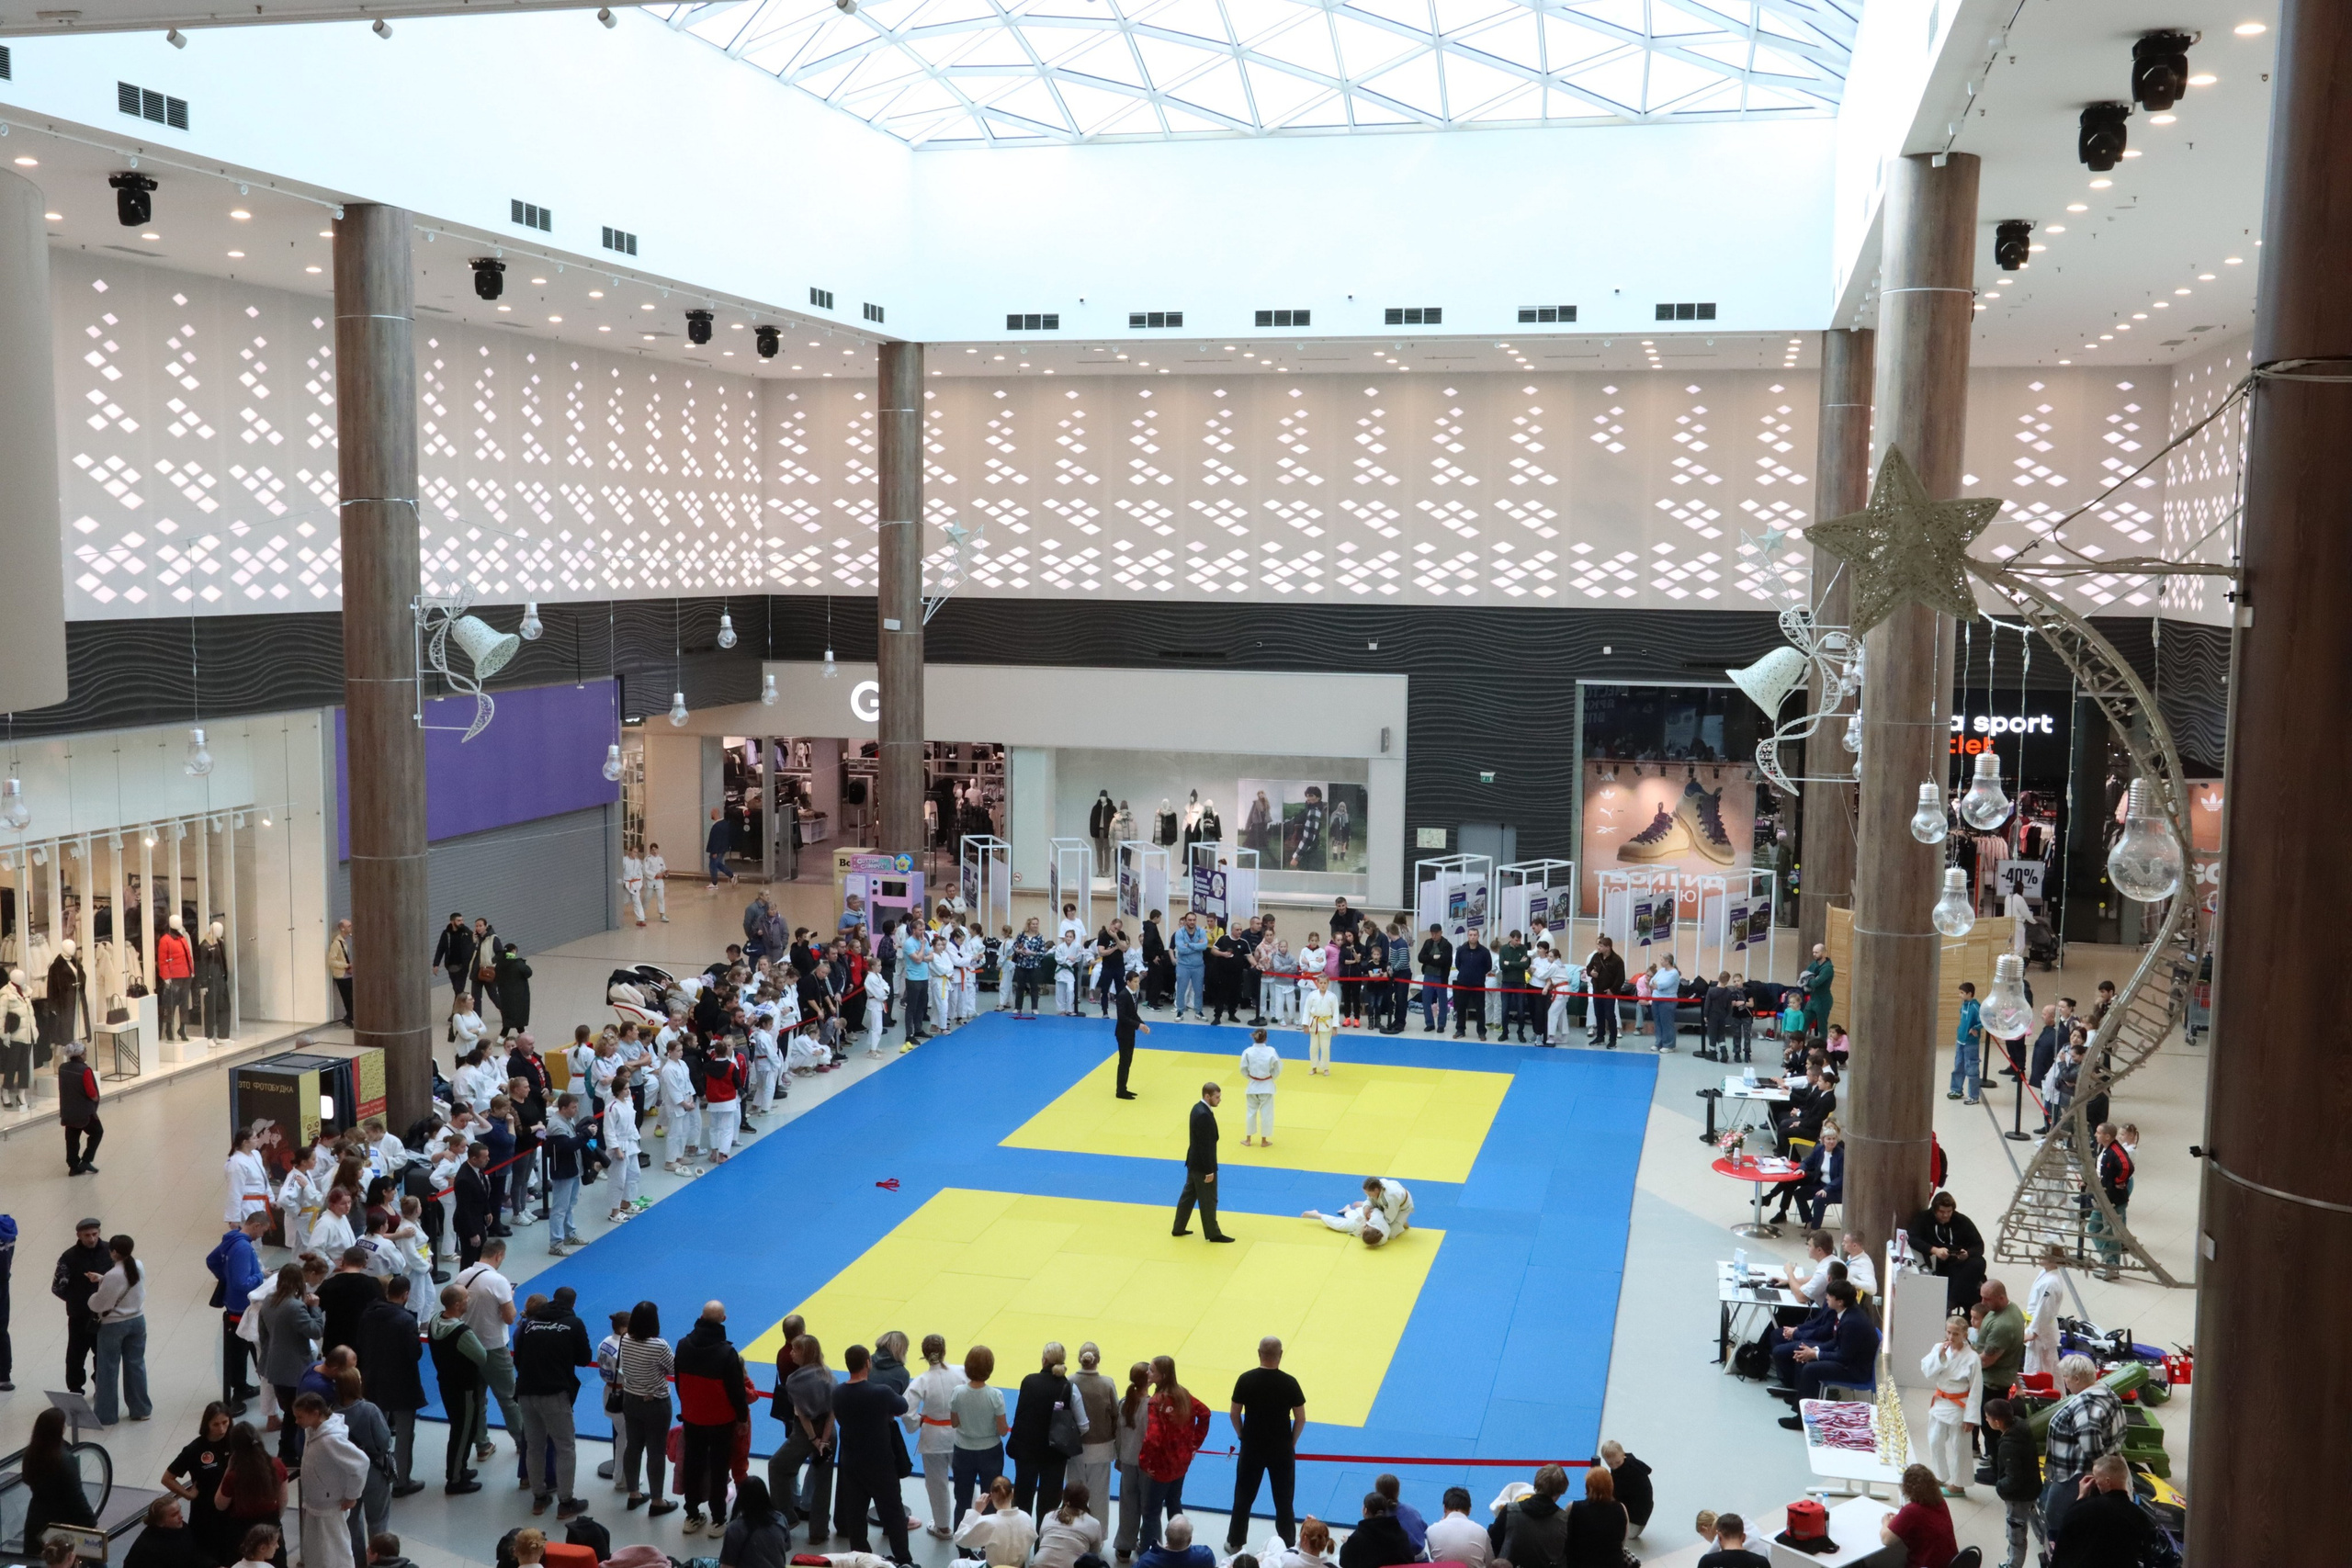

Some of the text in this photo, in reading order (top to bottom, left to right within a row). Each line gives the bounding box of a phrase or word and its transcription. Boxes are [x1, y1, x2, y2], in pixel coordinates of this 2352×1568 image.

[1973, 714, 2053, 737] sport
[2001, 867, 2038, 885] -40%
[238, 1080, 294, 1094] ЭТО ФОТОБУДКА
